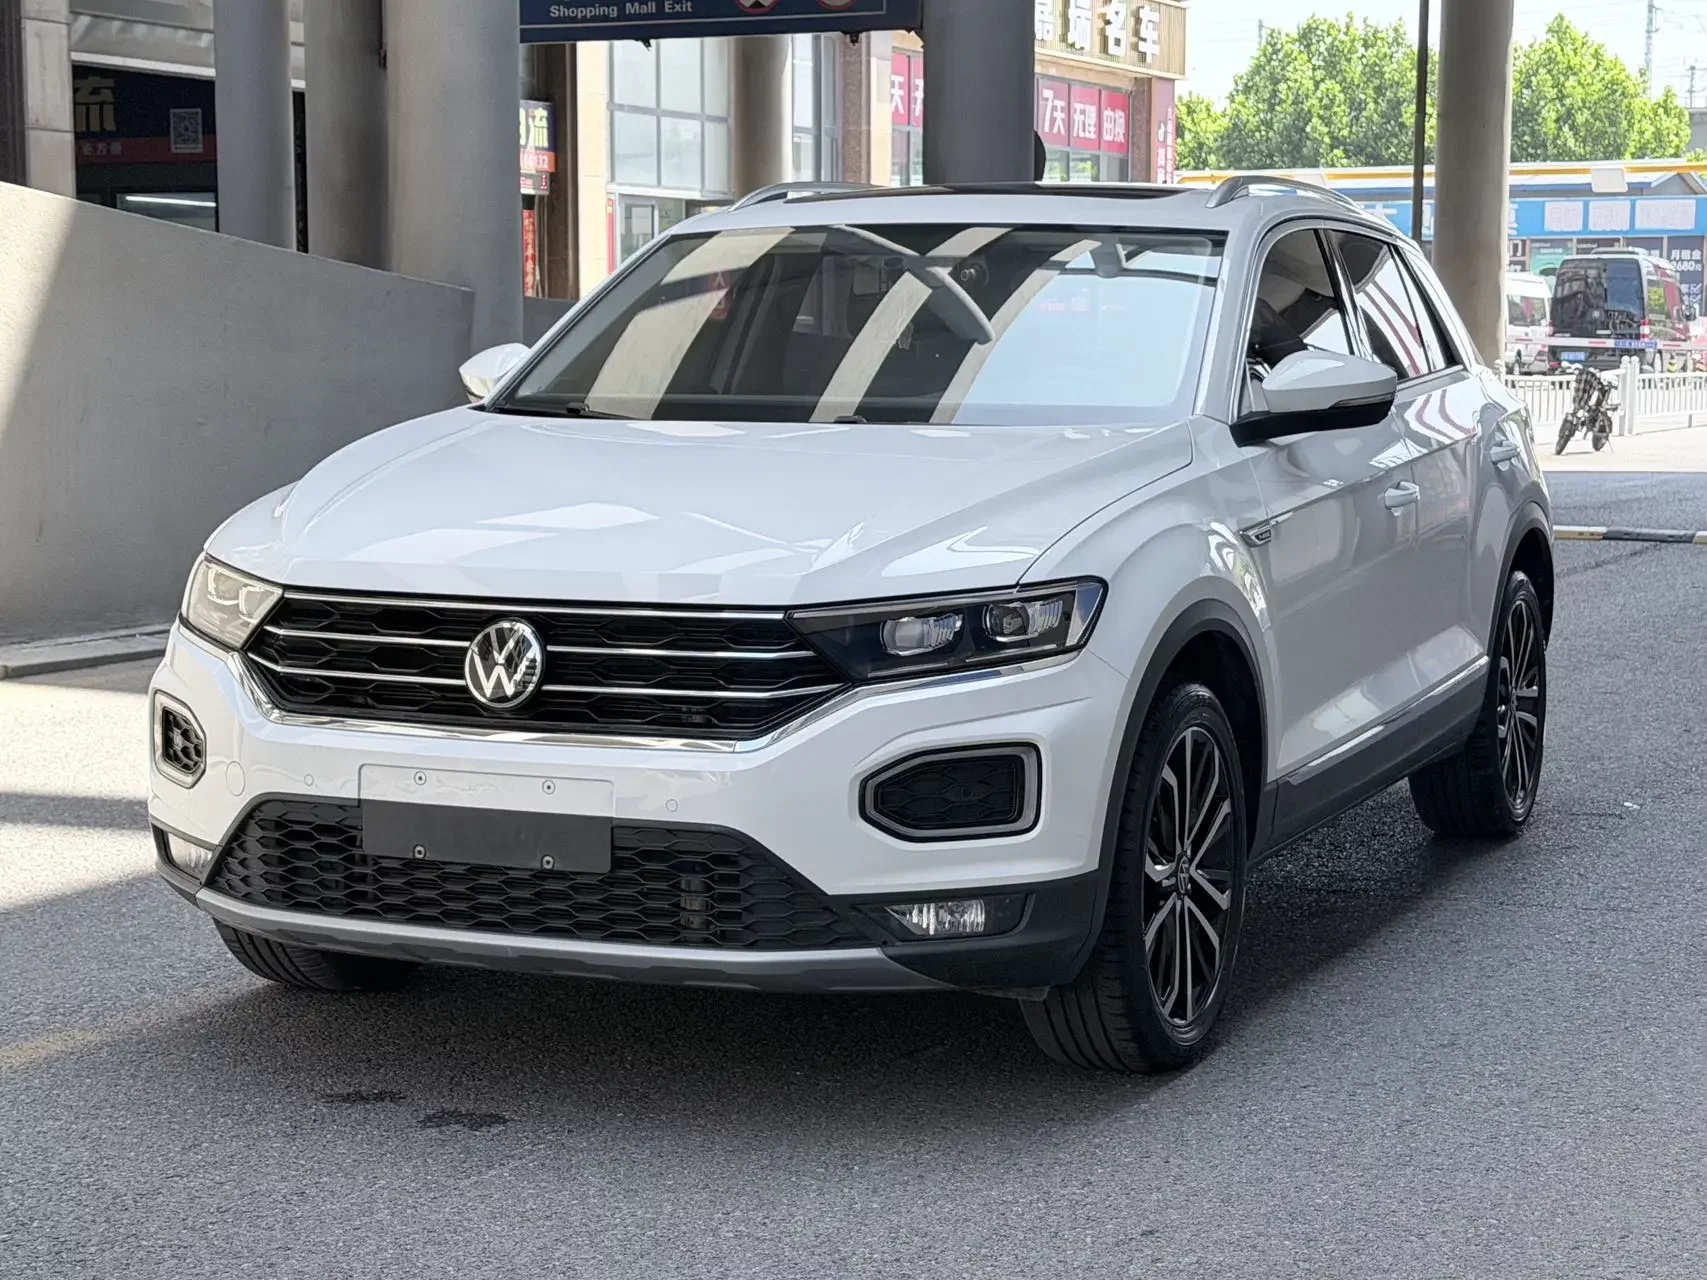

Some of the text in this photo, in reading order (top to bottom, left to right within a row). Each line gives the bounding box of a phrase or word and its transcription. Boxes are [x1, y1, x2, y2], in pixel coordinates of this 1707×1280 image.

[550, 0, 693, 18] Shopping Mall Exit
